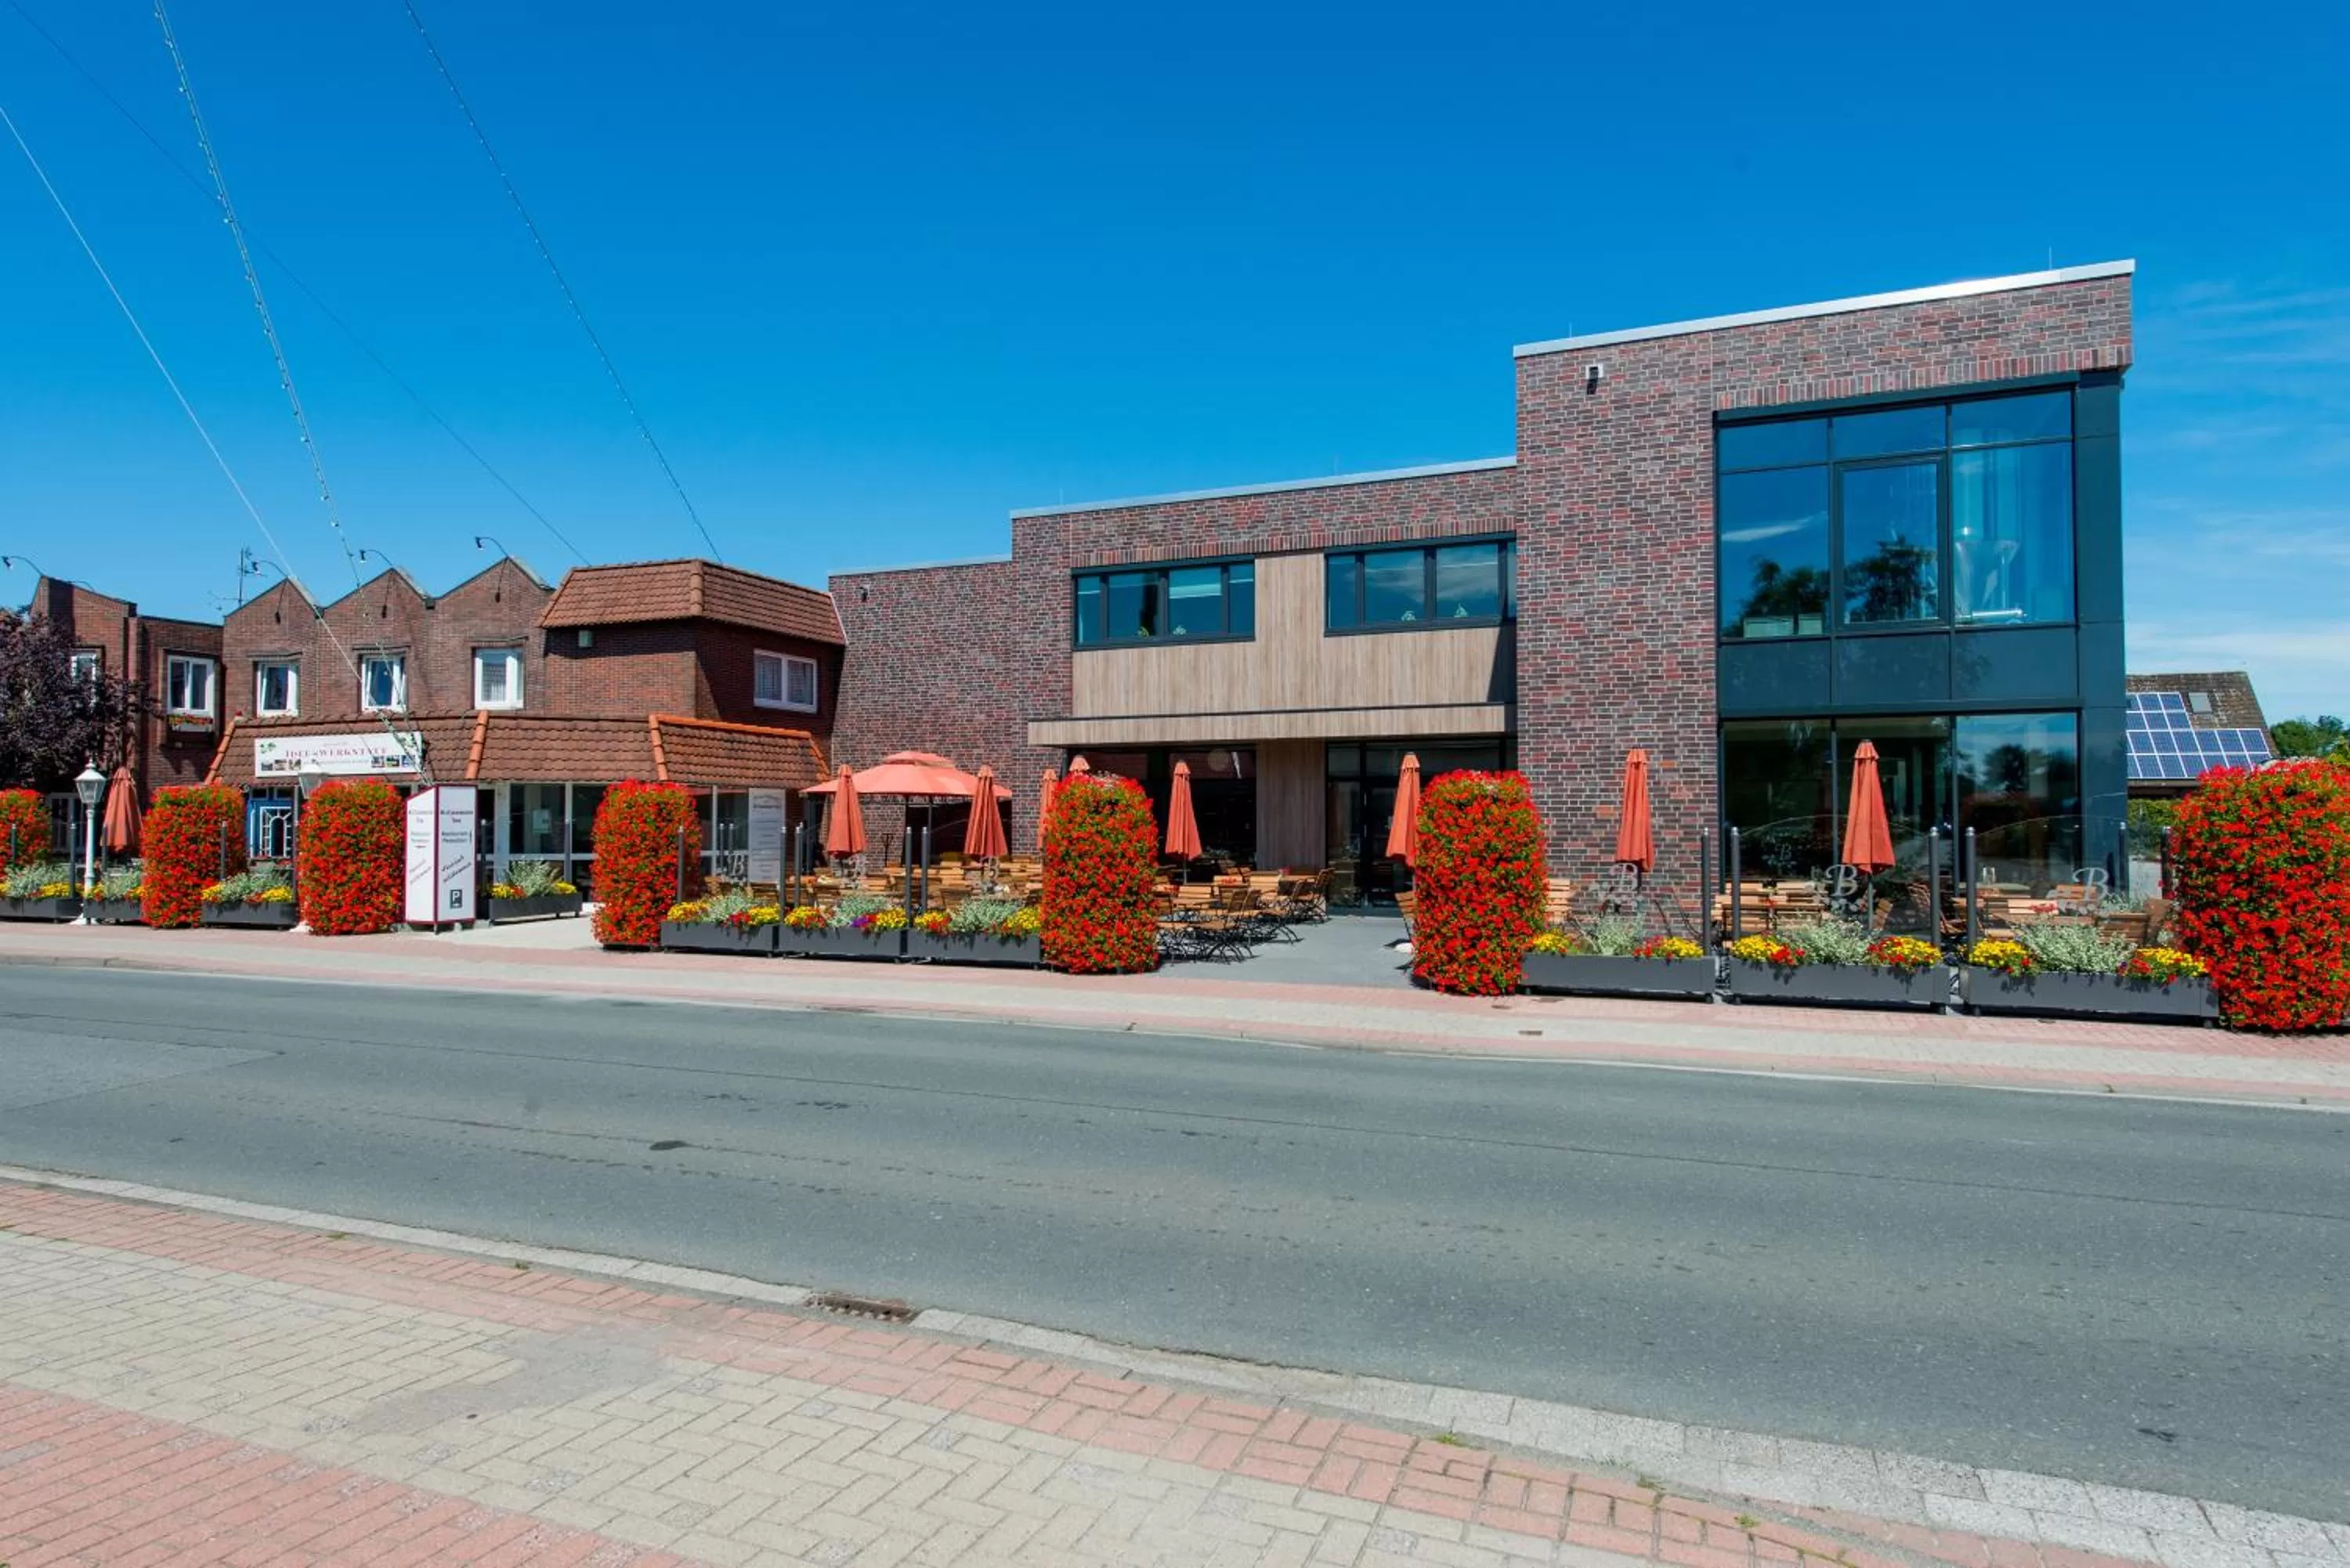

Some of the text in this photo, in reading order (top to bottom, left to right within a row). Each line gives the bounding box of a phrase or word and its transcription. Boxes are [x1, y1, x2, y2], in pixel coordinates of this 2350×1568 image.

[1608, 862, 1638, 892] B
[1825, 864, 1858, 897] B
[2072, 867, 2110, 901] B
[452, 891, 461, 901] P
